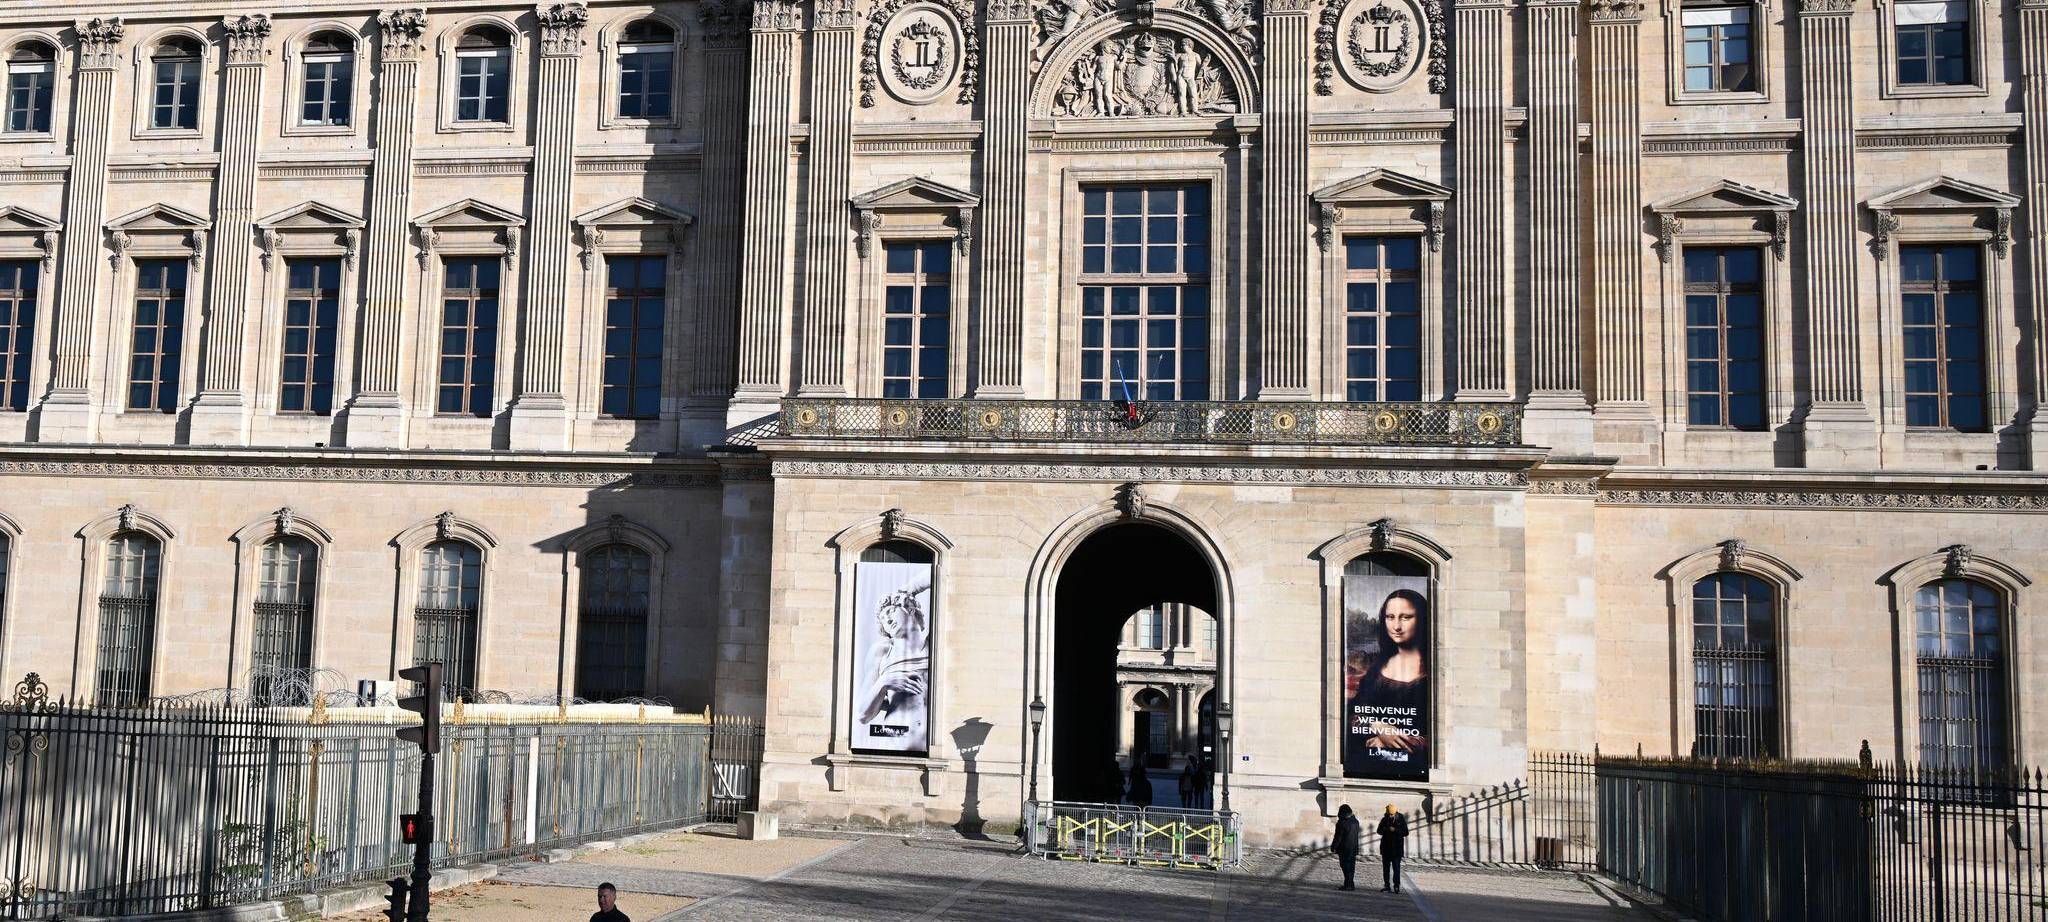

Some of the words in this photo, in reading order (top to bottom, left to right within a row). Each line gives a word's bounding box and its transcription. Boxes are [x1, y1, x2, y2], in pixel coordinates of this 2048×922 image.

[1354, 705, 1417, 716] BIENVENUE
[1358, 716, 1413, 726] WELCOME
[1352, 726, 1420, 737] BIENVENIDO
